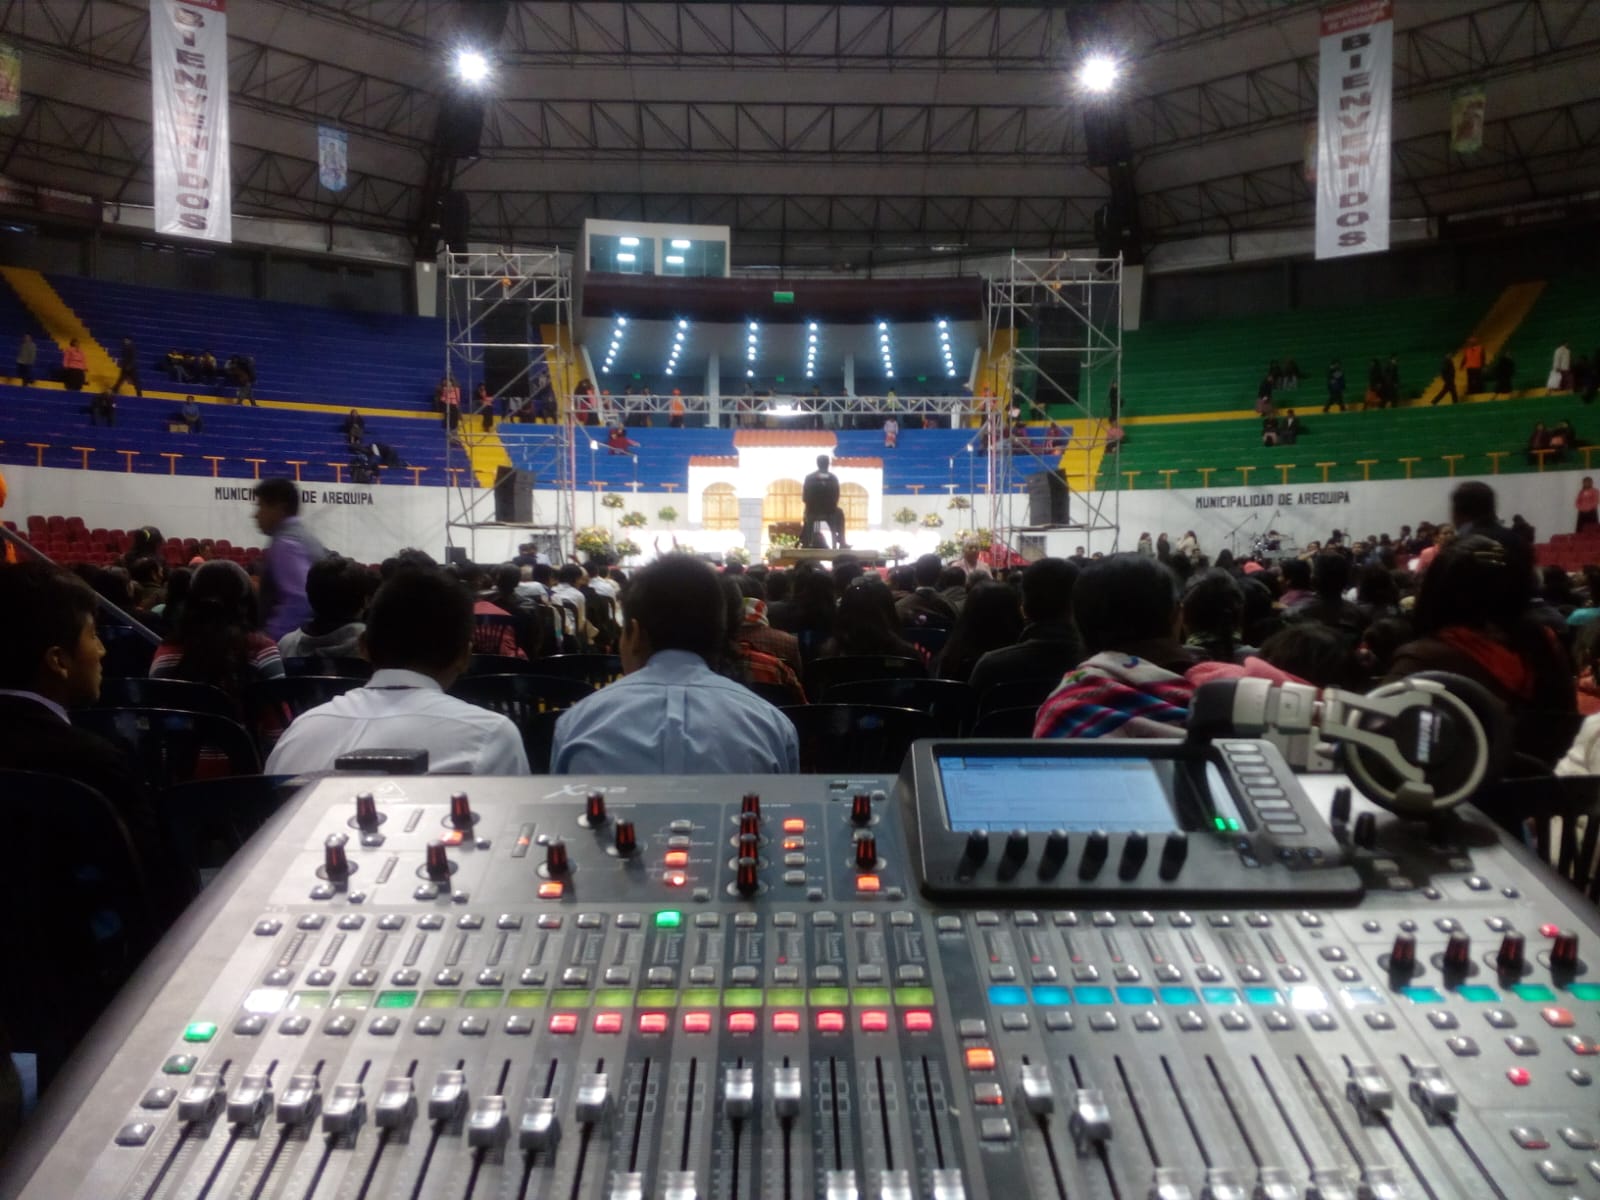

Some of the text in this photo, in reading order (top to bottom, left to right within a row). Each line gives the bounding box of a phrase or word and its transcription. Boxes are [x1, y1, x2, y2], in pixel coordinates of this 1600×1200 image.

[175, 7, 209, 230] BIENVENIDOS
[1336, 32, 1371, 248] BIENVENIDOS
[302, 490, 317, 503] DE
[322, 491, 374, 505] AREQUIPA
[1195, 491, 1350, 509] MUNICIPALIDAD DE AREQUIPA
